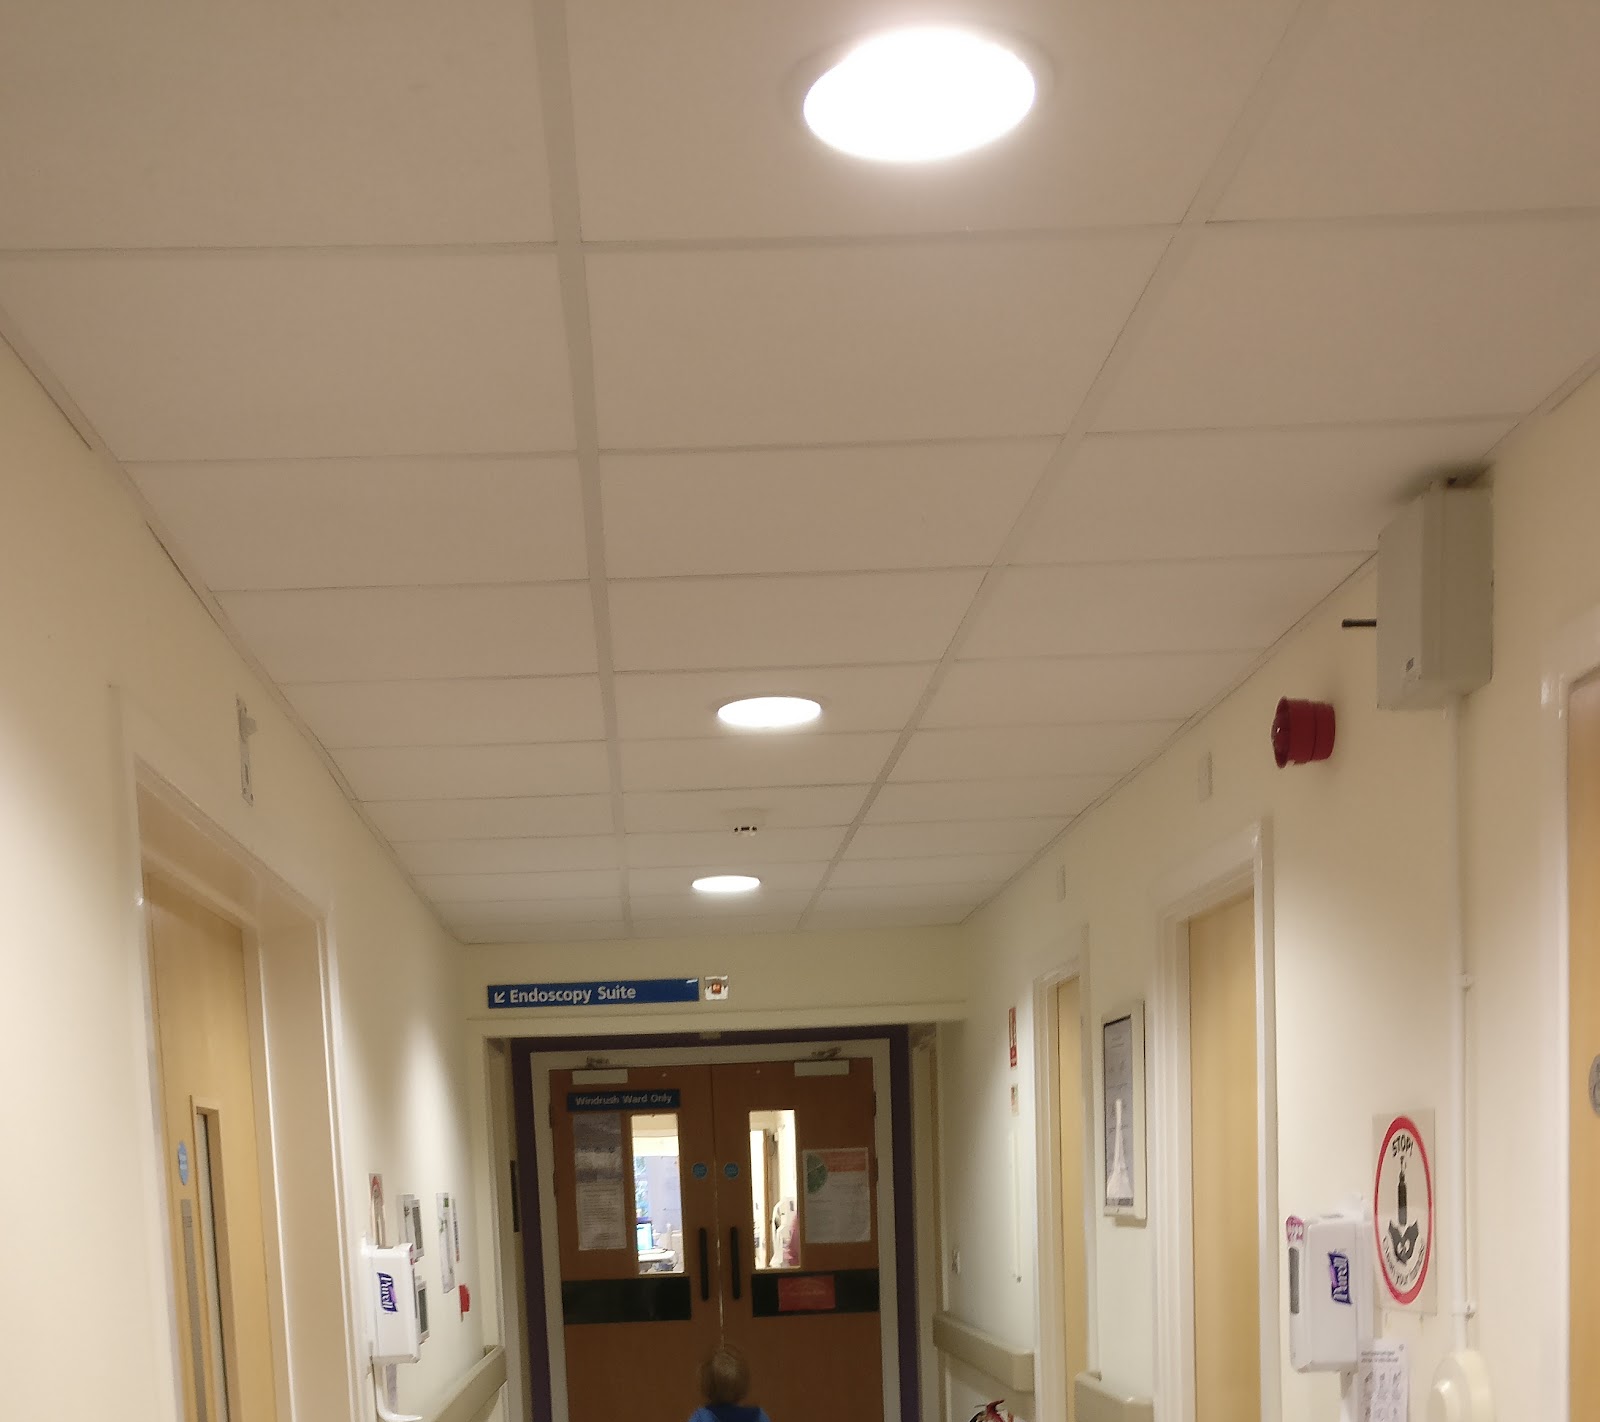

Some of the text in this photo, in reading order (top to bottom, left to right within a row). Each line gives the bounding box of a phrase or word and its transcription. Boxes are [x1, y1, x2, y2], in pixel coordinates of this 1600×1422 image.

[510, 985, 636, 1004] Endoscopy Suite
[575, 1093, 672, 1106] Windrush Ward Only
